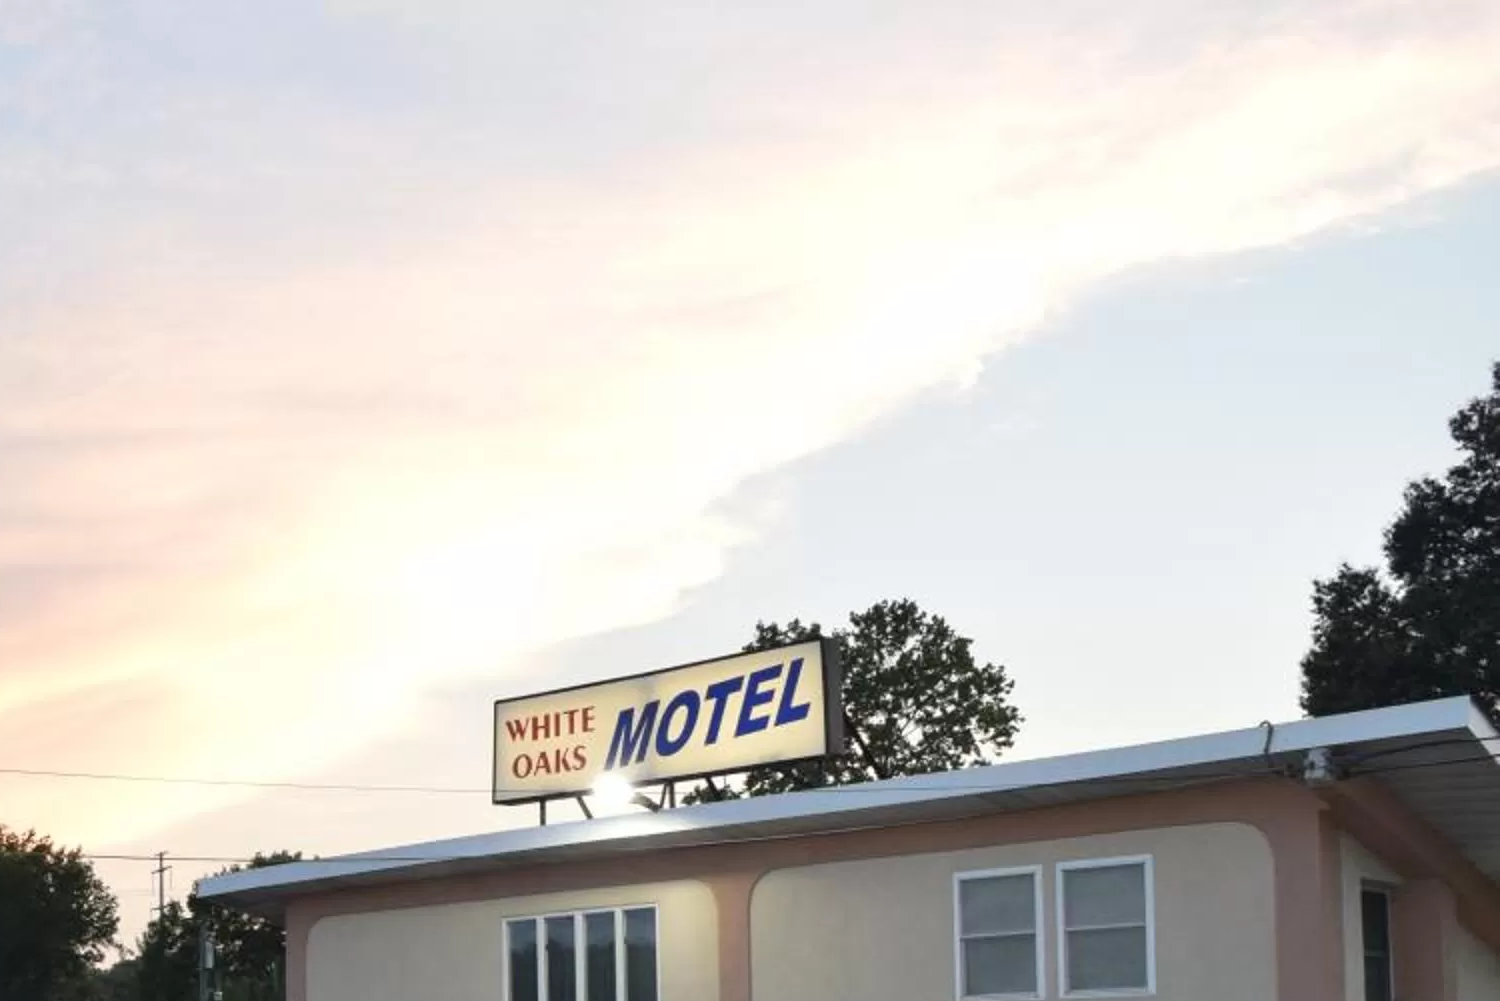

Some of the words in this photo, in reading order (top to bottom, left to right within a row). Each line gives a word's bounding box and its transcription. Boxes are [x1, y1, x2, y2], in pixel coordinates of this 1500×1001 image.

[505, 706, 595, 741] WHITE
[604, 658, 810, 770] MOTEL
[512, 746, 587, 779] OAKS
